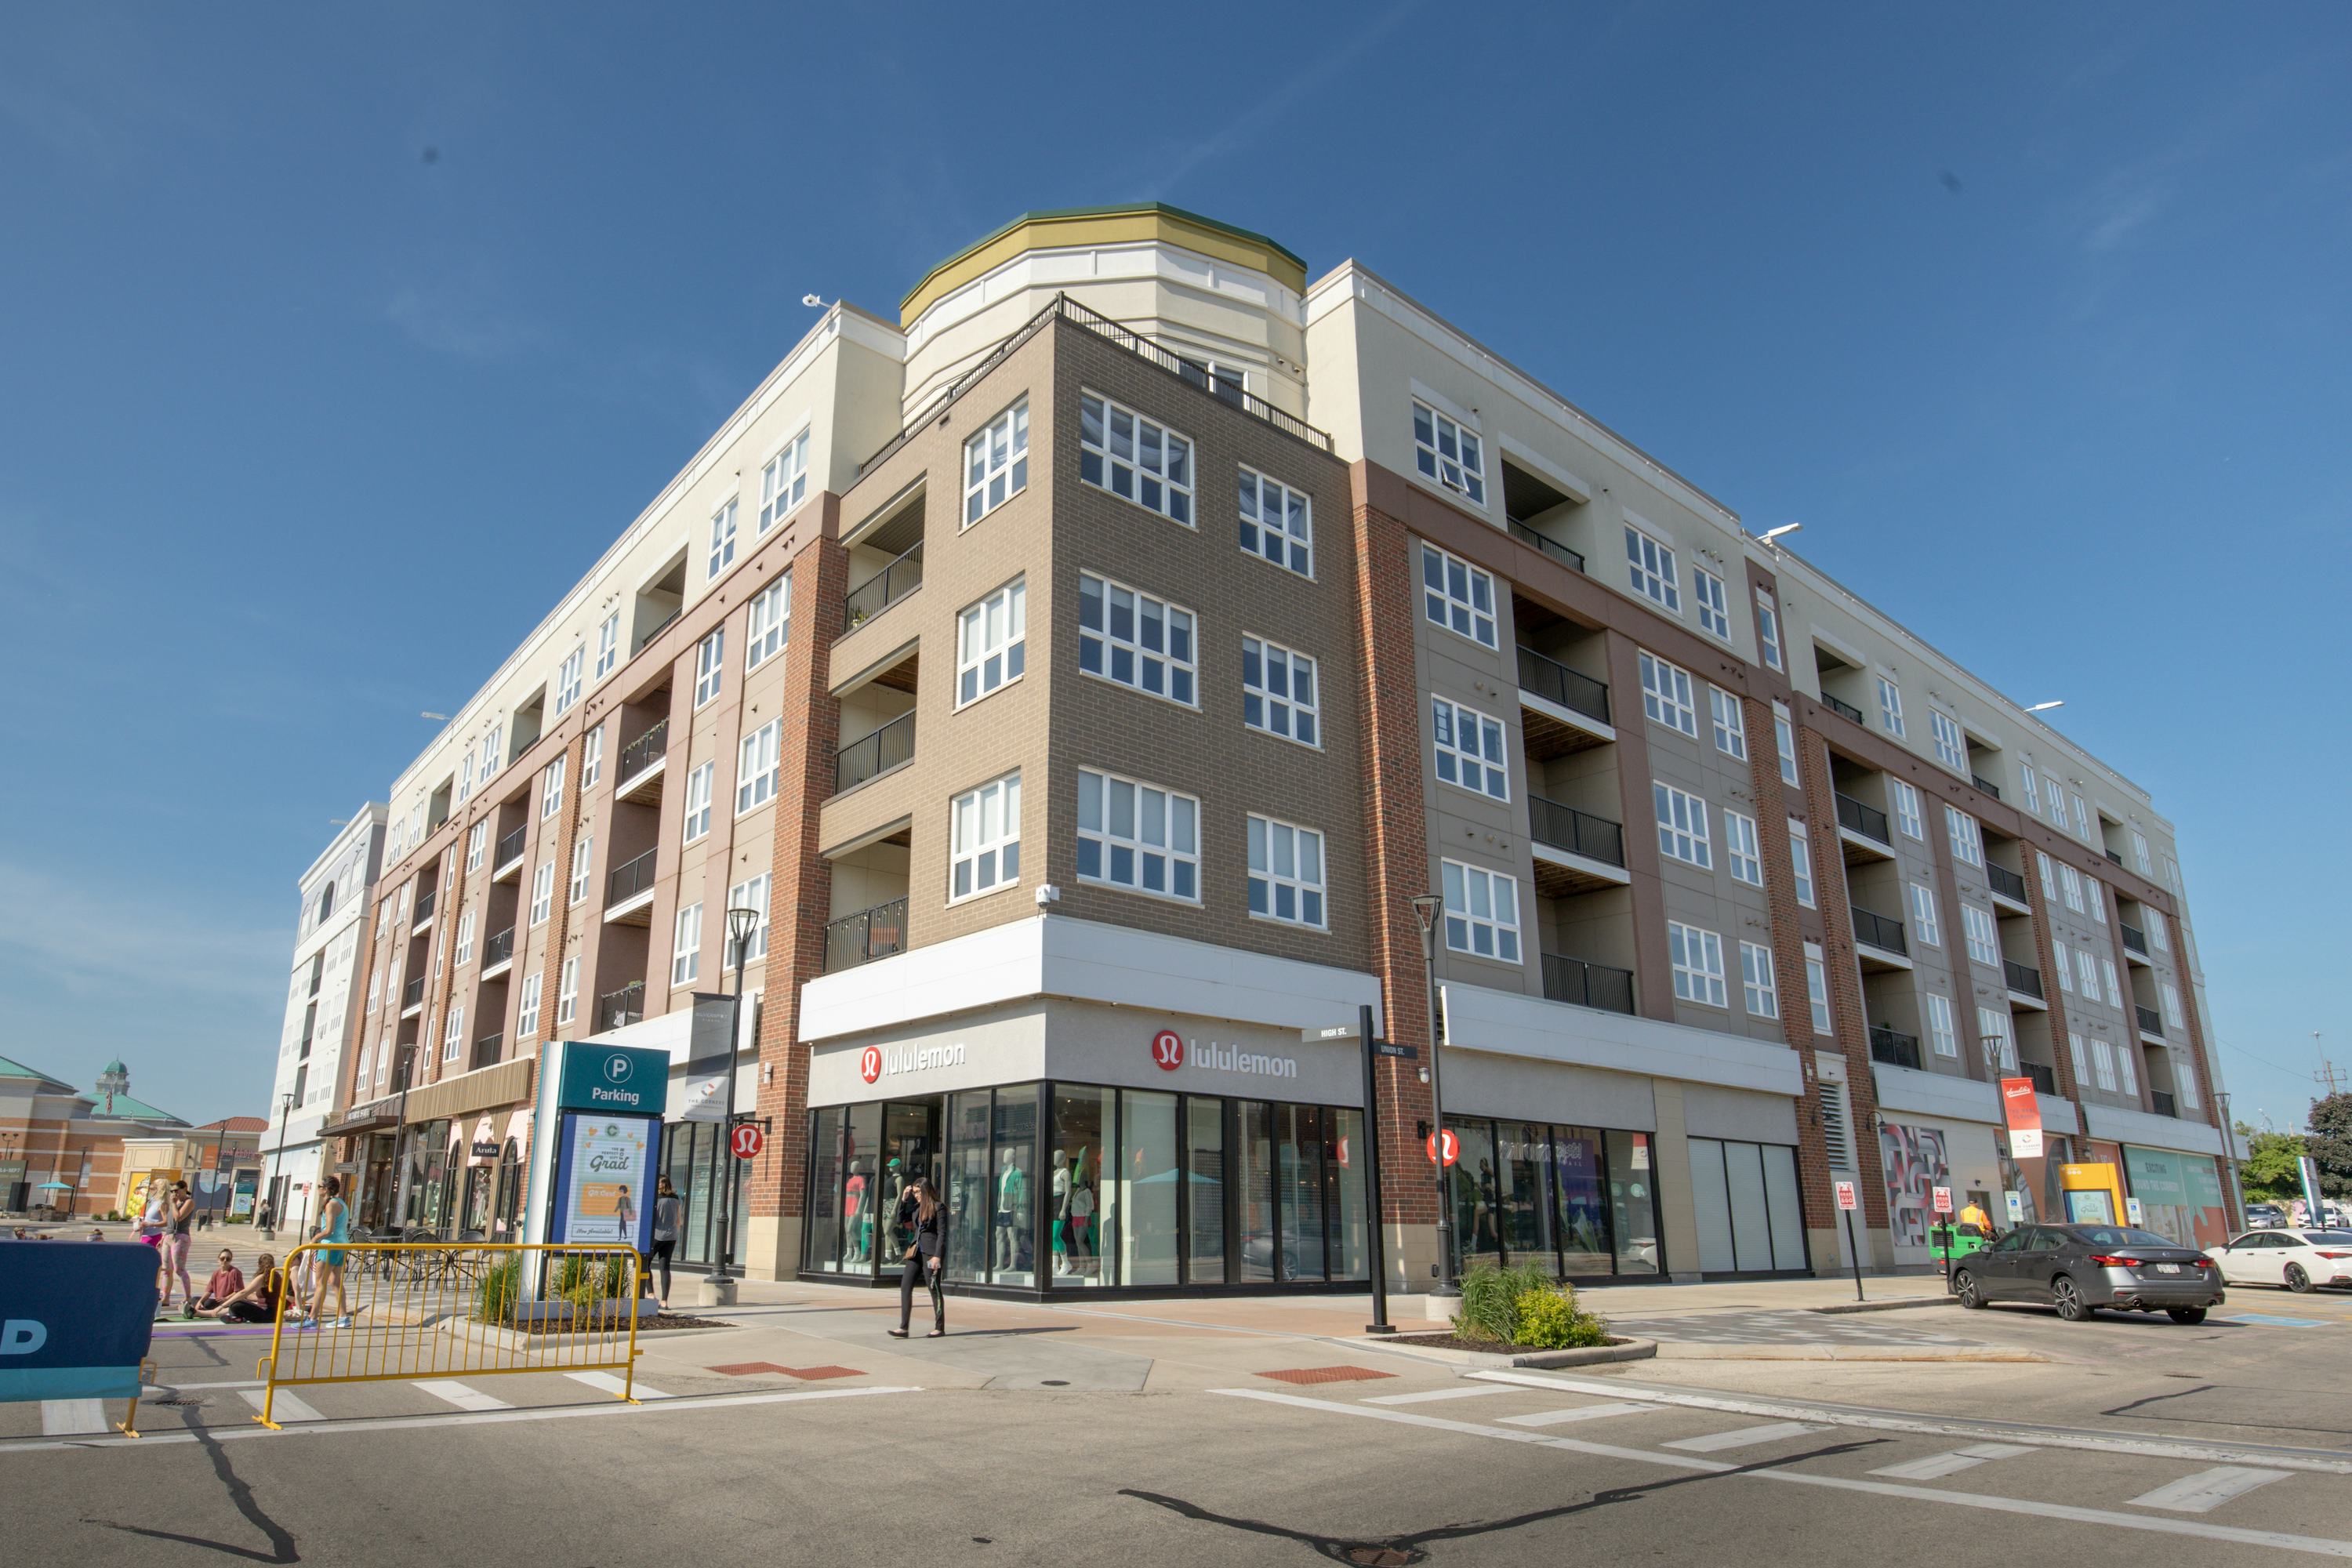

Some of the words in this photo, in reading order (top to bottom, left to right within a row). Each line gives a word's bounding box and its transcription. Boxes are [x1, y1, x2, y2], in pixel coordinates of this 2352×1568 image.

[1321, 1029, 1337, 1037] HIGH
[1338, 1027, 1347, 1036] ST.
[1190, 1039, 1298, 1078] lululemon
[1381, 1045, 1396, 1054] UNION
[884, 1044, 966, 1076] lululemon
[592, 1087, 640, 1105] Parking
[590, 1155, 630, 1172] Grad
[0, 1319, 47, 1355] D
